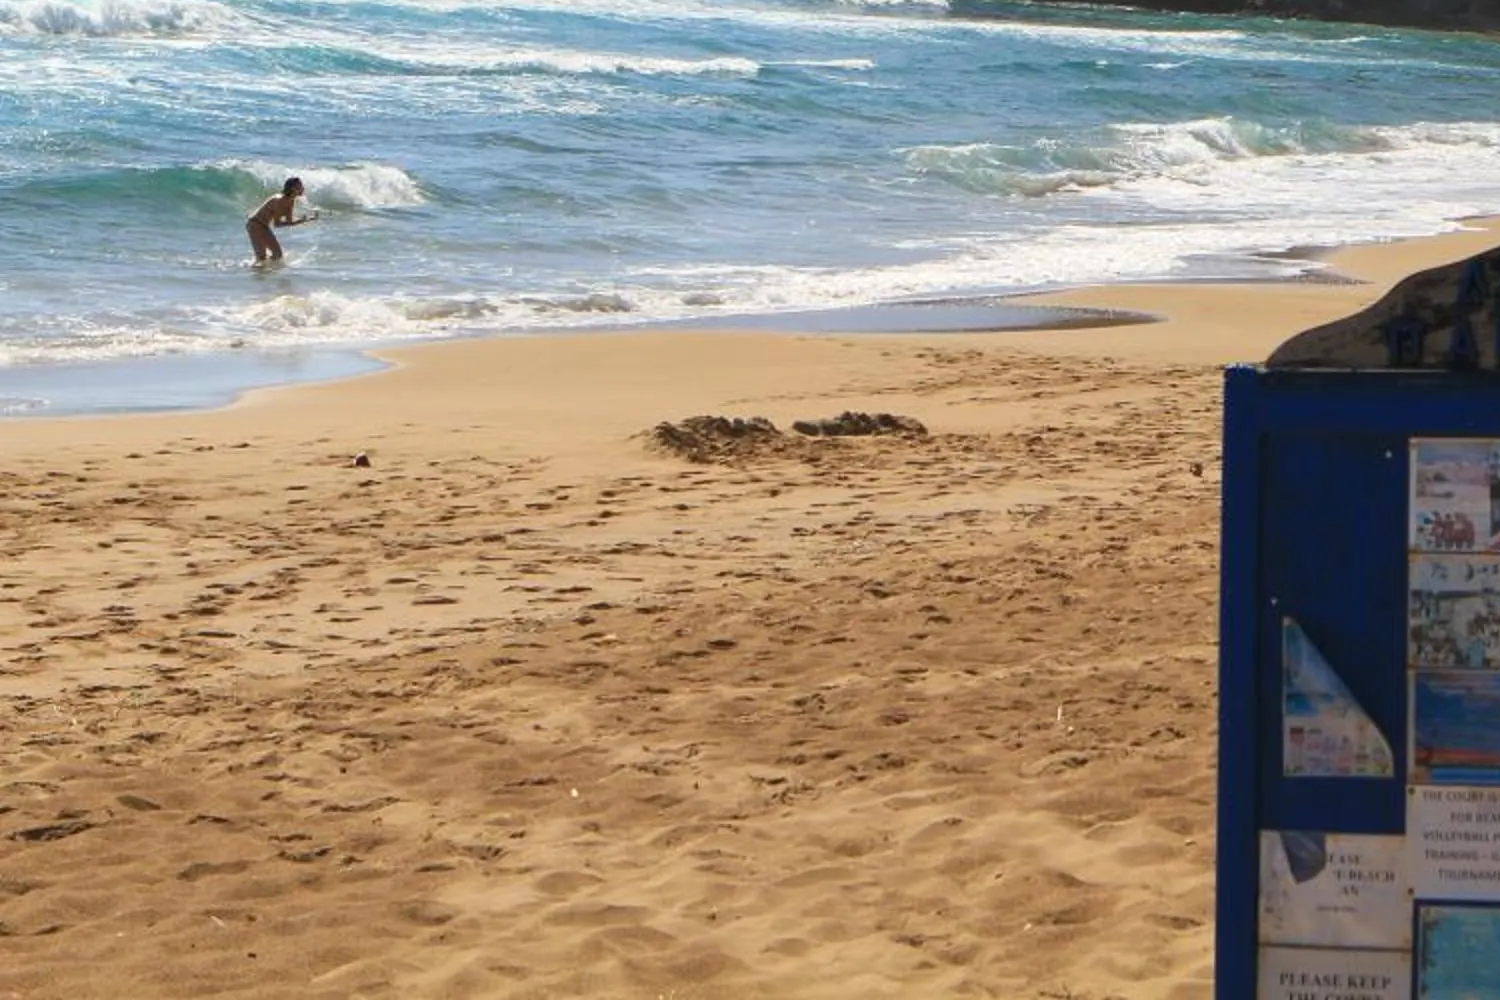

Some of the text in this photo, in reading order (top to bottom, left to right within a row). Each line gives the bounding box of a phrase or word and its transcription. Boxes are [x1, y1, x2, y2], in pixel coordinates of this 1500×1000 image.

[1422, 791, 1442, 801] THE
[1445, 791, 1484, 803] COURT
[1450, 811, 1473, 823] FOR
[1422, 830, 1490, 842] VOLLEYBALL
[1425, 849, 1479, 861] TRAINING
[1279, 971, 1392, 991] PLEASE KEEP
